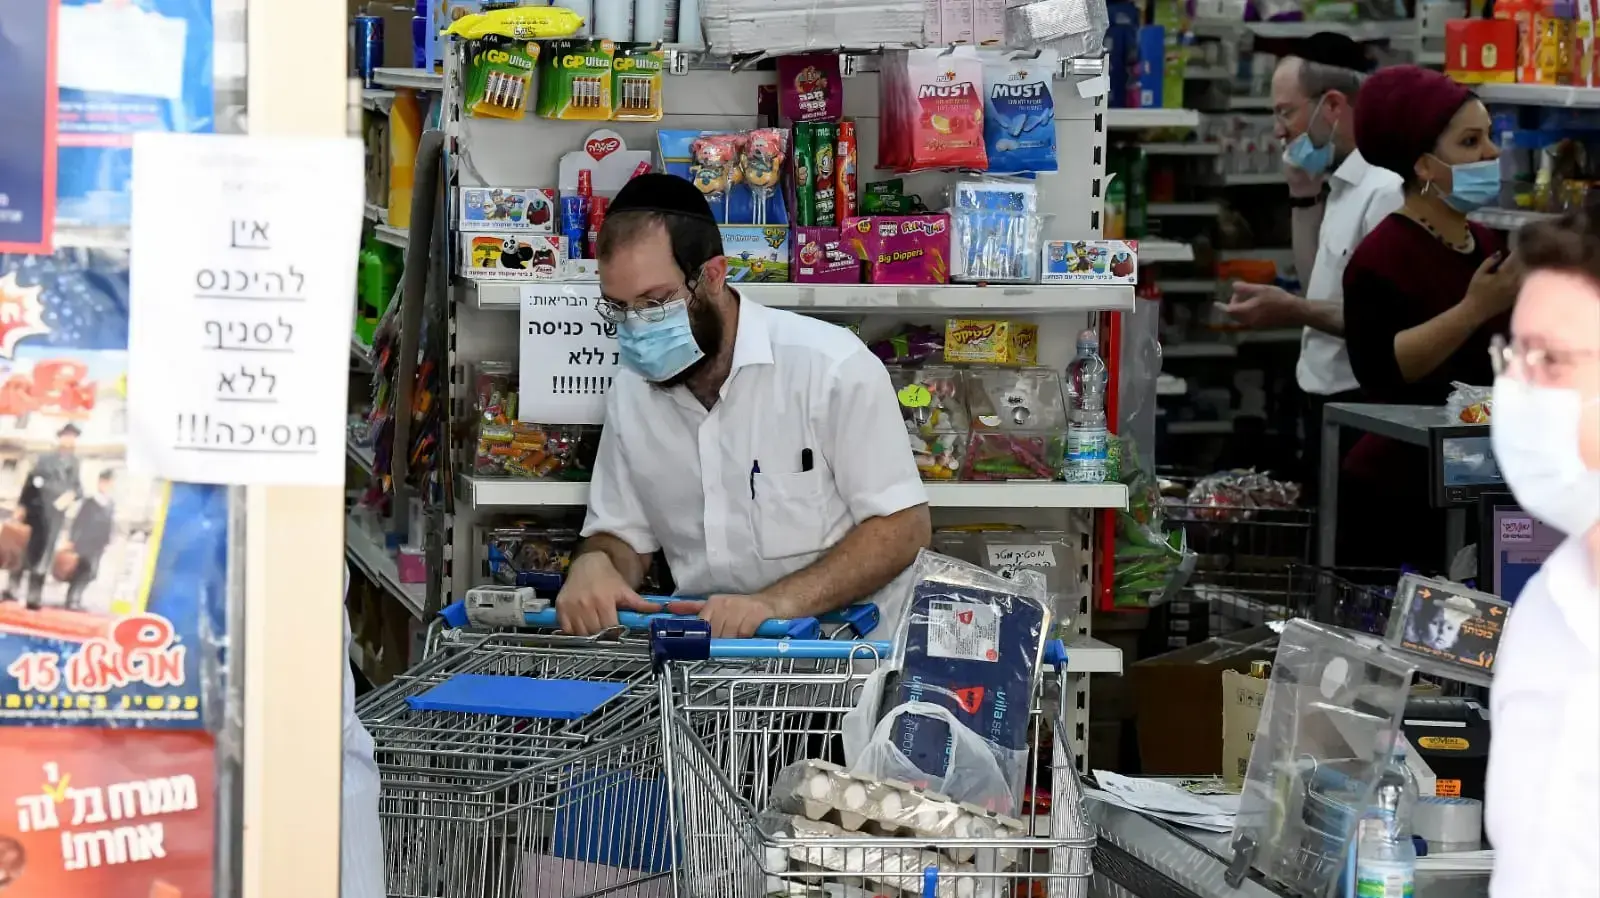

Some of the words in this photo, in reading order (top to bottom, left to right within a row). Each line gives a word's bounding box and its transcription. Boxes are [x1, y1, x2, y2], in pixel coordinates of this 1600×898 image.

[487, 49, 510, 64] GP
[509, 55, 532, 69] Ultra
[562, 55, 585, 69] GP
[585, 56, 609, 67] Ultra
[612, 57, 635, 71] GP
[635, 59, 660, 69] Ultra
[918, 81, 972, 99] MUST
[991, 81, 1044, 99] MUST
[230, 219, 270, 248] אין
[878, 254, 892, 264] Big
[893, 248, 924, 261] Dippers
[195, 266, 305, 293] להיכנס
[529, 295, 588, 307] הבריאות:
[204, 316, 294, 349] לסניף
[528, 320, 584, 336] כניסה
[590, 321, 618, 336] שר
[568, 347, 605, 365] ללא
[217, 366, 278, 394] ללא
[176, 413, 318, 446] מסיכה!!!
[9, 653, 58, 691] 15
[0, 694, 108, 709] בחנויות
[993, 690, 1008, 720] villa
[902, 712, 920, 757] EAFOOD
[107, 773, 199, 820] ממרח
[60, 821, 168, 872] אחרת!
